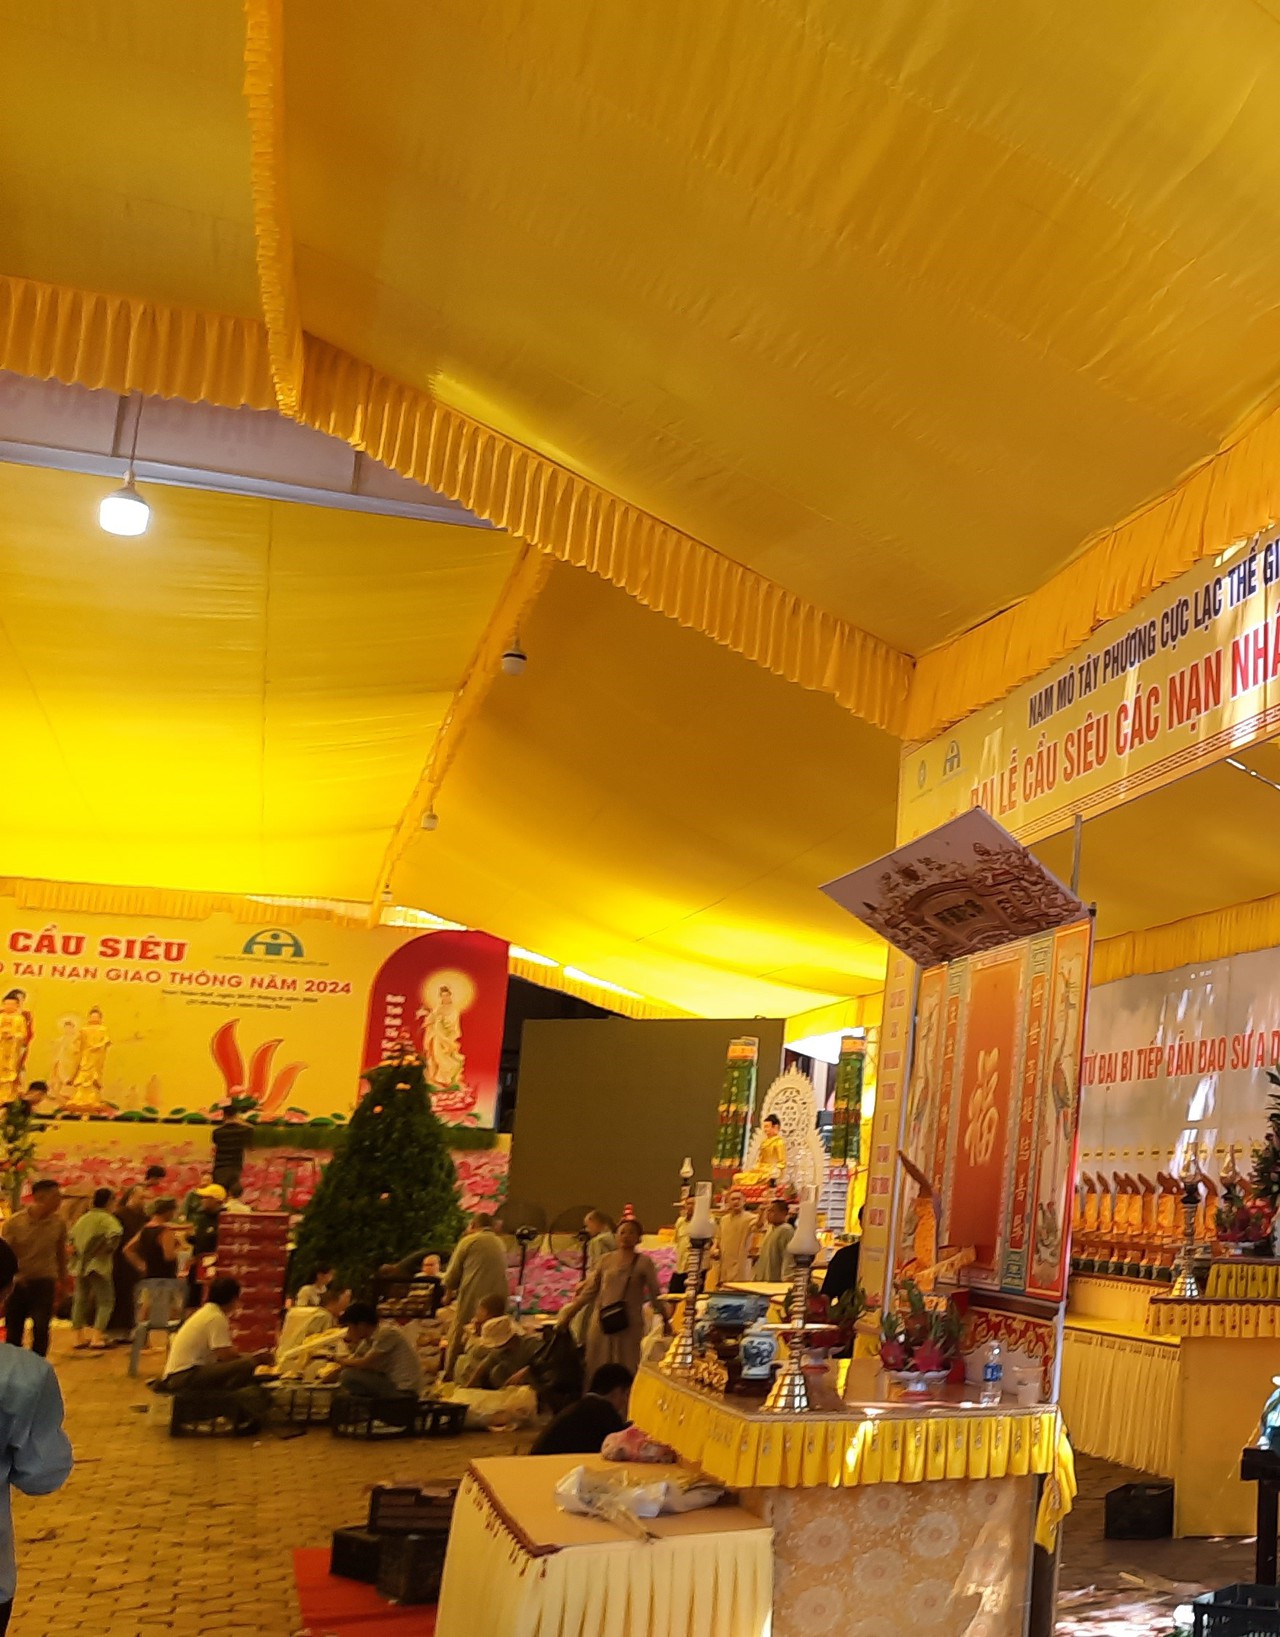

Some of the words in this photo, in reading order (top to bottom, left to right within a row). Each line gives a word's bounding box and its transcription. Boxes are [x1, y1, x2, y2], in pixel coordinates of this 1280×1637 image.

[1028, 688, 1054, 728] NAM
[1057, 664, 1076, 713] MÔ
[1078, 652, 1100, 700] TÂY
[1102, 619, 1156, 684] PHƯƠNG
[1160, 597, 1190, 651] CỰC
[1193, 574, 1223, 632] LẠC
[1227, 539, 1259, 603] THẾ
[998, 748, 1018, 816] LỄ
[1023, 731, 1058, 804] CẦU
[1063, 712, 1108, 783] SIÊU
[1116, 683, 1160, 757] CÁC
[1168, 649, 1223, 733] NẠN
[9, 924, 85, 956] CẦU
[100, 935, 187, 962] SIÊU
[14, 962, 43, 976] TAI
[51, 965, 97, 982] NẠN
[106, 967, 161, 983] GIAO
[170, 970, 242, 988] THÔNG
[251, 974, 297, 991] NĂM
[304, 979, 351, 994] 2024
[1121, 1050, 1132, 1081] BI
[1137, 1036, 1163, 1080] TIẾP
[1198, 1037, 1226, 1080] ĐẠO
[1231, 1030, 1253, 1069] SƯ
[1255, 1032, 1265, 1067] A
